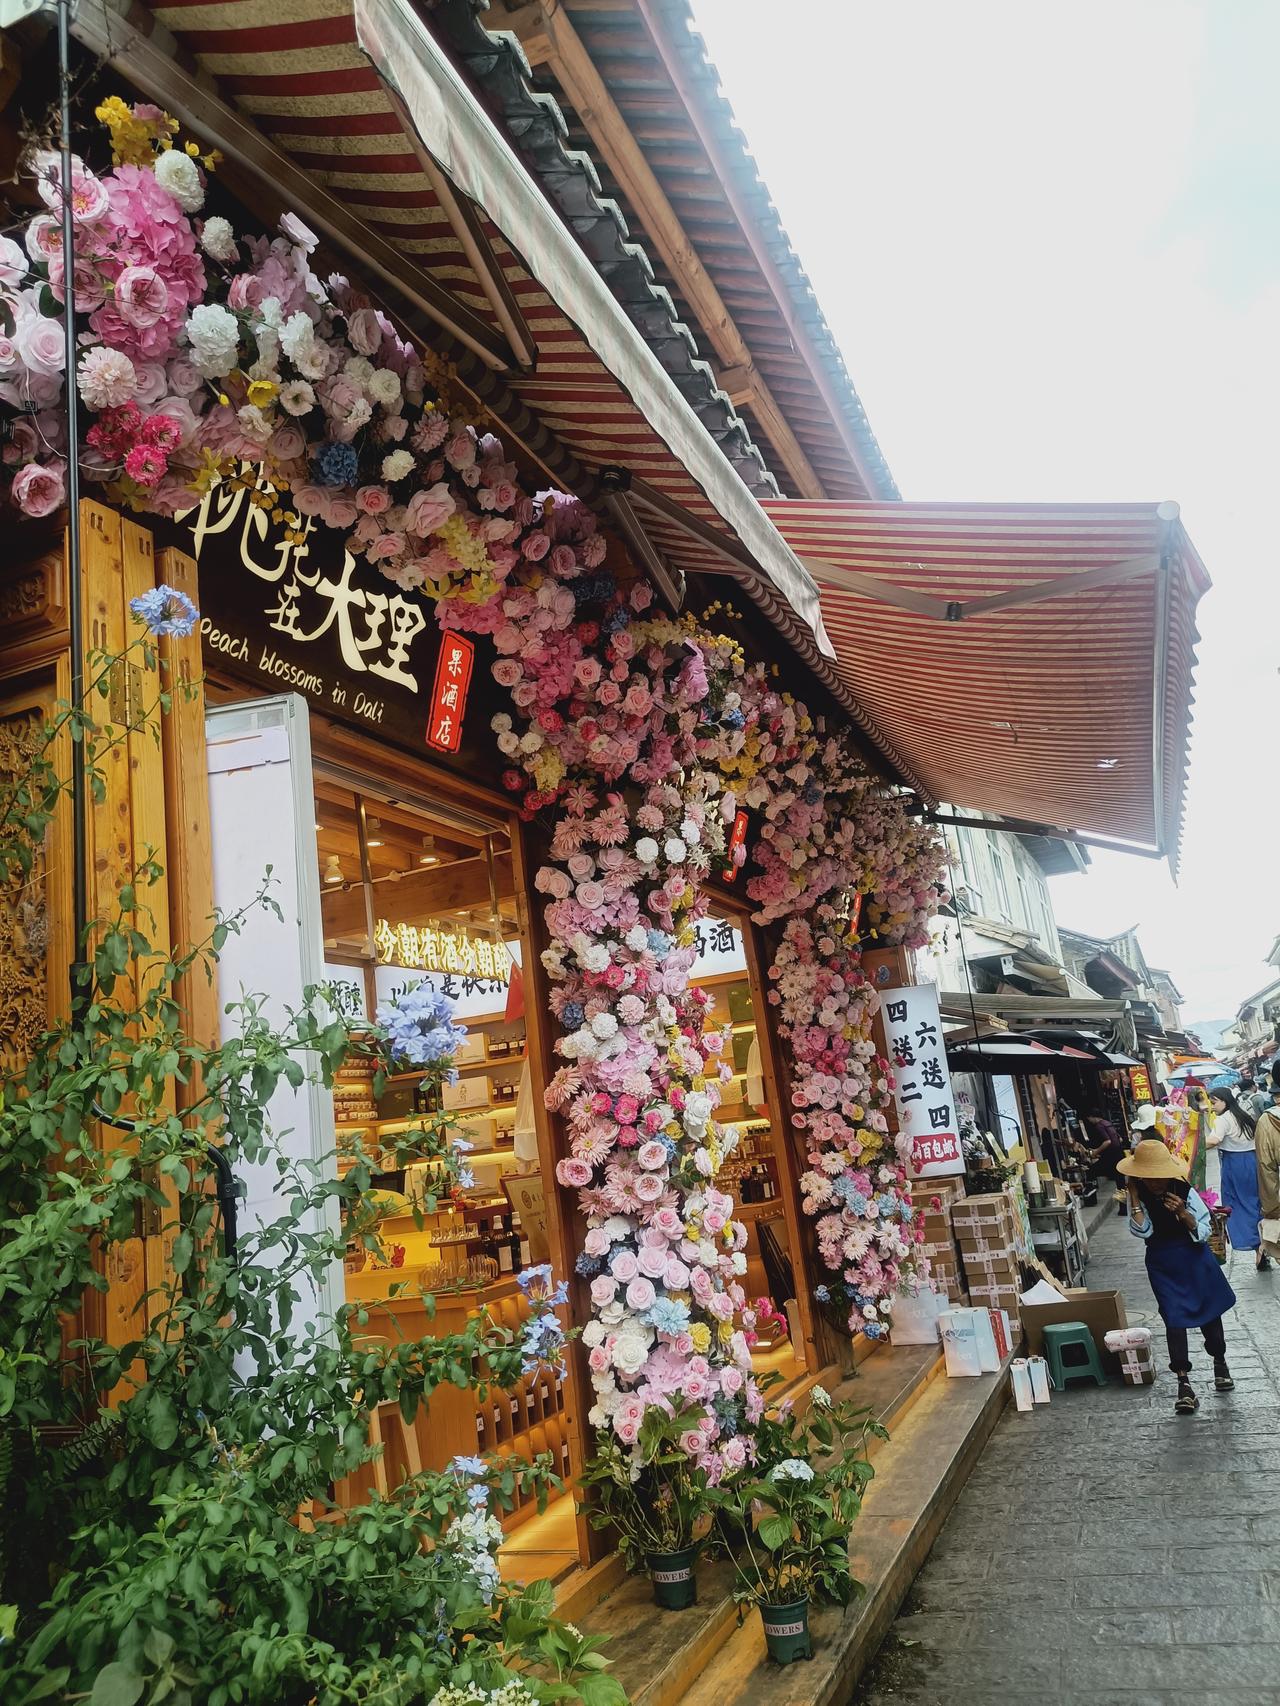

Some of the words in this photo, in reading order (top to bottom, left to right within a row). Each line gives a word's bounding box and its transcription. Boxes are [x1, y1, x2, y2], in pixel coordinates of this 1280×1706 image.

[259, 645, 323, 695] blossoms
[332, 681, 347, 706] in
[353, 691, 385, 724] Dali
[435, 648, 463, 745] 果酒店
[374, 918, 512, 983] 今朝有酒今朝醉
[886, 1000, 923, 1104] 四送二
[914, 1021, 950, 1128] 六送四
